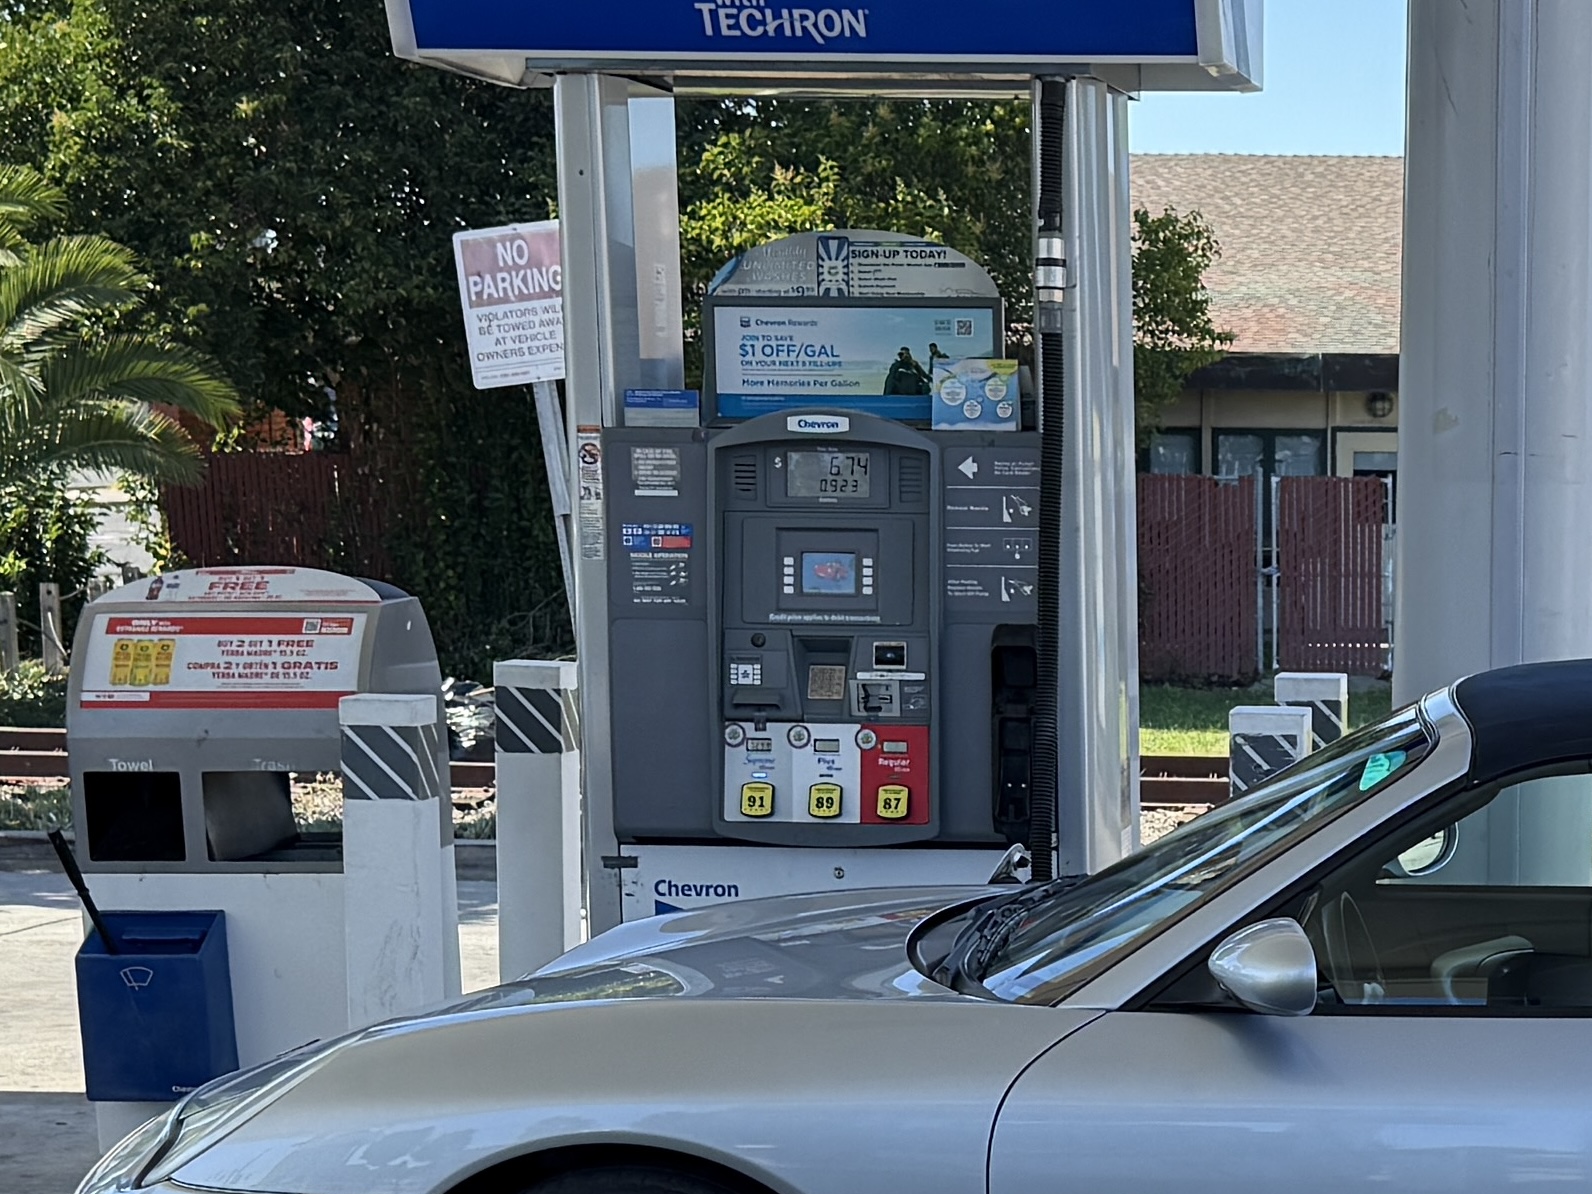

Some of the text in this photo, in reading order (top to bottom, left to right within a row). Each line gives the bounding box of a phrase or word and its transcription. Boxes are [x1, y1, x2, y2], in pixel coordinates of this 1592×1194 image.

[694, 3, 868, 44] TECHRON
[496, 239, 529, 267] NO
[851, 249, 947, 259] SIGN-UP TODAY!
[468, 265, 562, 301] PARKING
[477, 305, 562, 324] VIOLATORS WIL
[478, 317, 563, 336] BE TOWED AWA
[494, 330, 557, 347] AT VEHICLE
[761, 334, 772, 342] TO
[476, 342, 564, 362] OWNERS EXPEN
[739, 343, 840, 358] $1 OFF/GAL
[742, 379, 765, 387] More
[813, 379, 828, 387] Per
[797, 419, 839, 429] Chevron
[208, 580, 270, 591] FREE
[236, 640, 246, 648] 2
[277, 639, 315, 648] FREE
[223, 661, 233, 670] 2
[271, 661, 278, 670] 1
[281, 661, 339, 670] GRATIS
[108, 759, 154, 771] Towel
[747, 796, 765, 809] 91
[815, 797, 834, 810] 89
[883, 798, 902, 811] 87
[654, 879, 739, 897] Chevron
